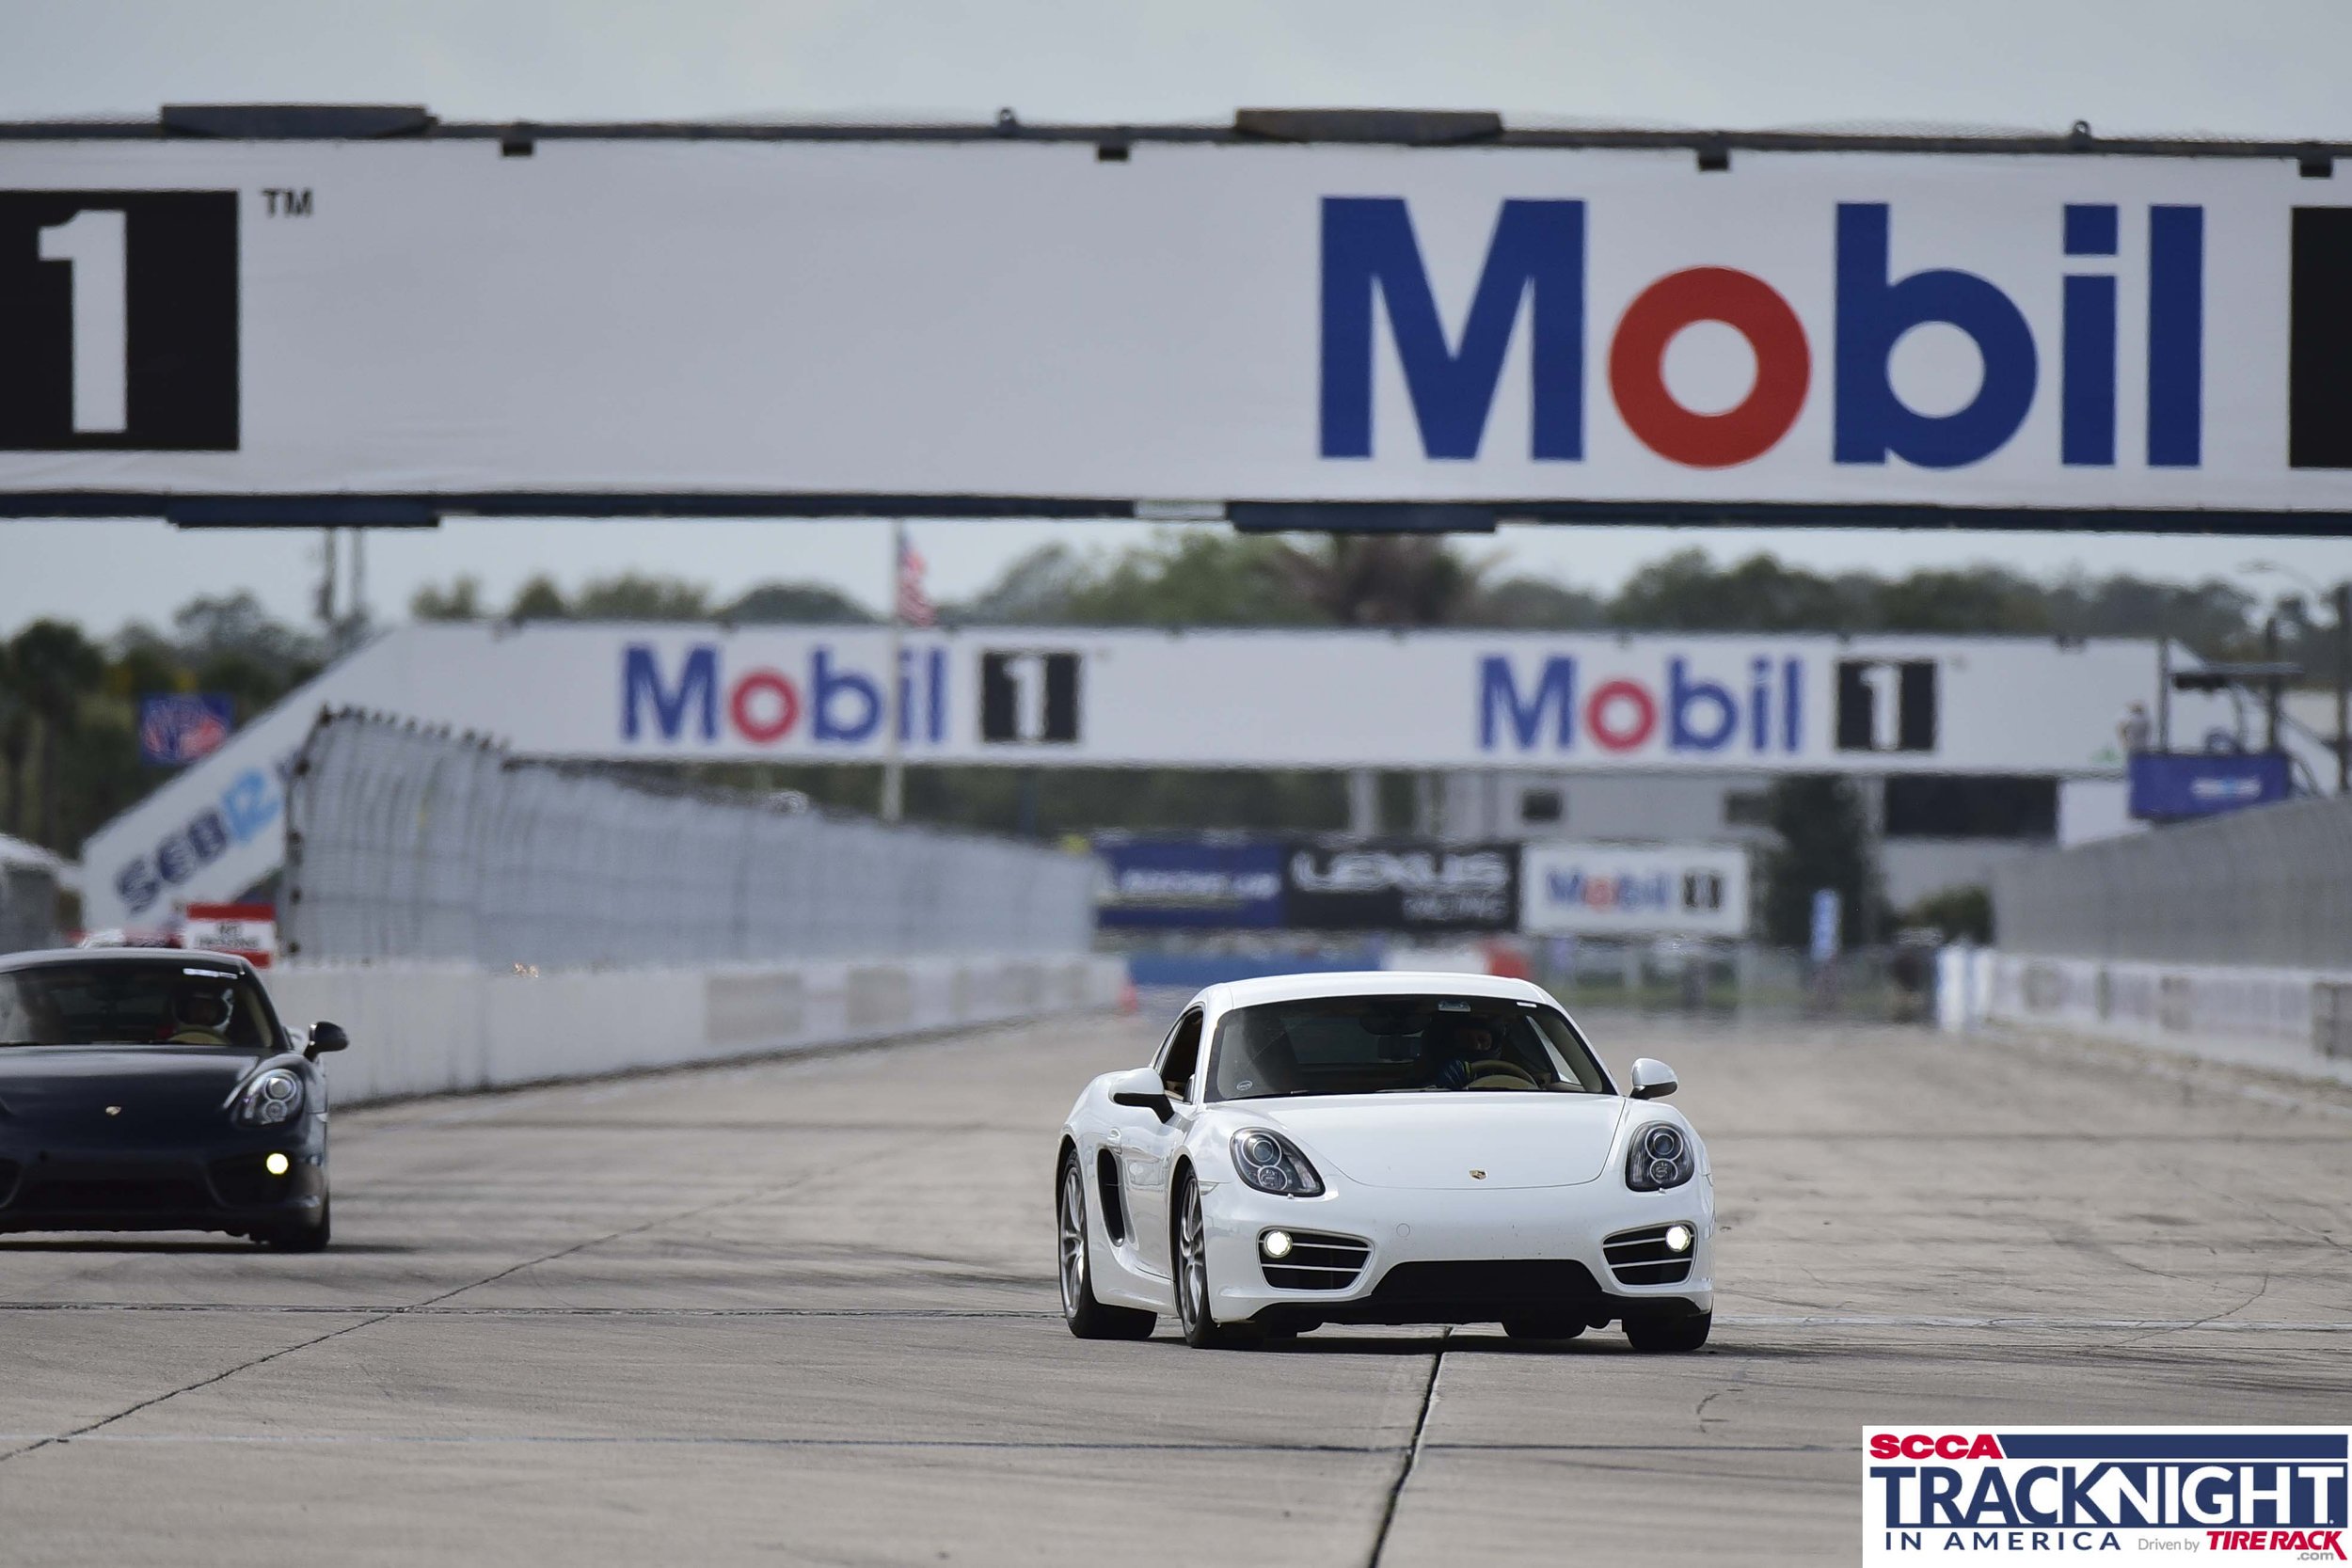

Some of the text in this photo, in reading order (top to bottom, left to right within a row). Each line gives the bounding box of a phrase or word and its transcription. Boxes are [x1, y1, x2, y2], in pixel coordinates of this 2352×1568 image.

[38, 189, 313, 434] 1 TM
[1319, 197, 2204, 469] Mobil
[623, 646, 946, 743] Mobil
[1479, 656, 1802, 753] Mobil
[1290, 850, 1509, 892] LEXUS
[1548, 867, 1670, 913] Mobil
